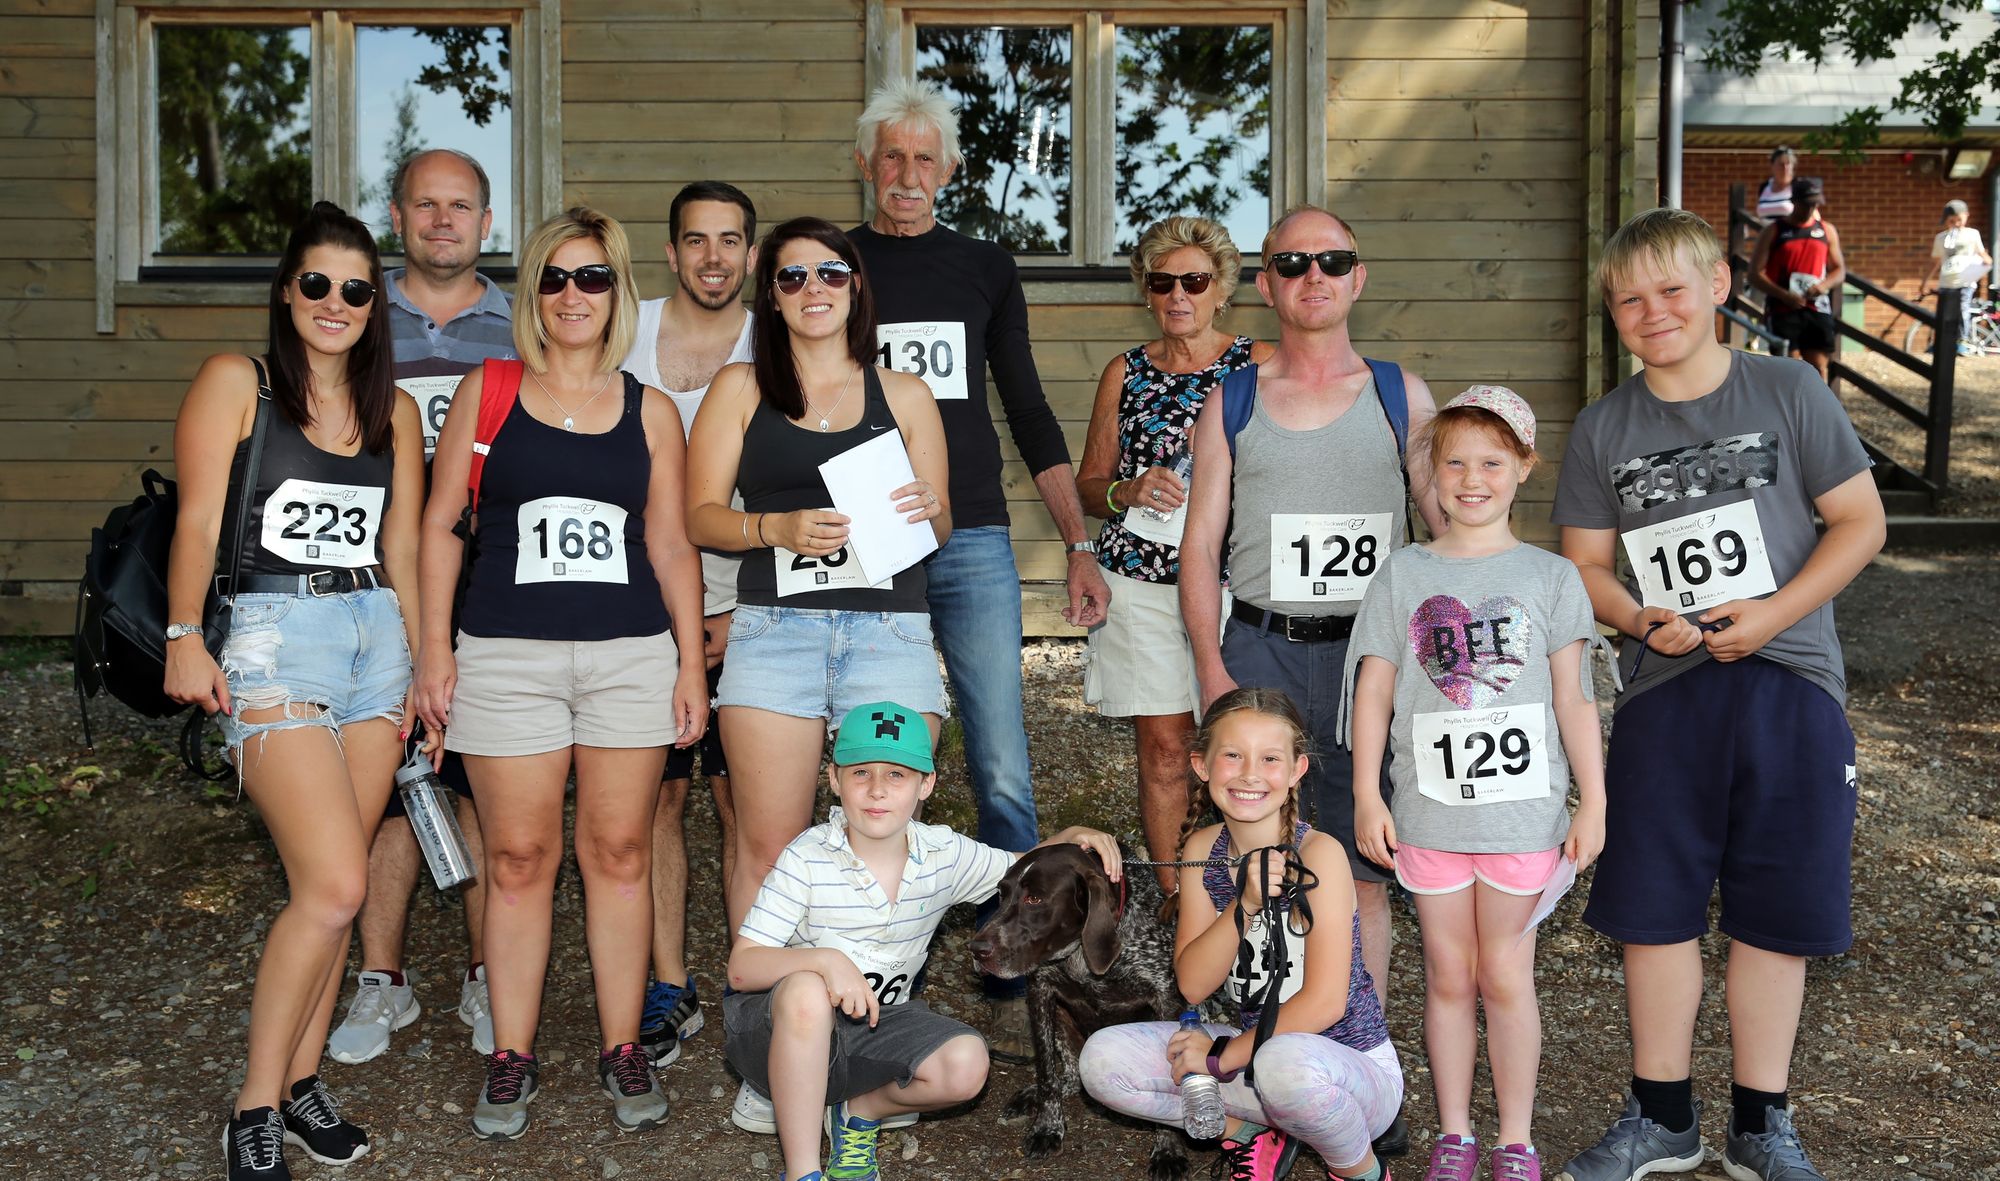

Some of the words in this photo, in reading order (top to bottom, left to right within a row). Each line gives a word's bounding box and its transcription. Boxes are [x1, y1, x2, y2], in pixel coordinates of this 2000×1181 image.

[878, 340, 954, 378] 130
[1632, 449, 1762, 499] adidas
[280, 501, 367, 546] 223
[532, 517, 613, 561] 168
[1654, 527, 1672, 538] Phyllis
[1672, 520, 1698, 534] Tuckwell
[1290, 534, 1377, 577] 128
[1650, 529, 1748, 592] 169
[1443, 717, 1462, 725] Phyllis
[1463, 714, 1490, 724] Tuckwell
[1433, 727, 1531, 779] 129
